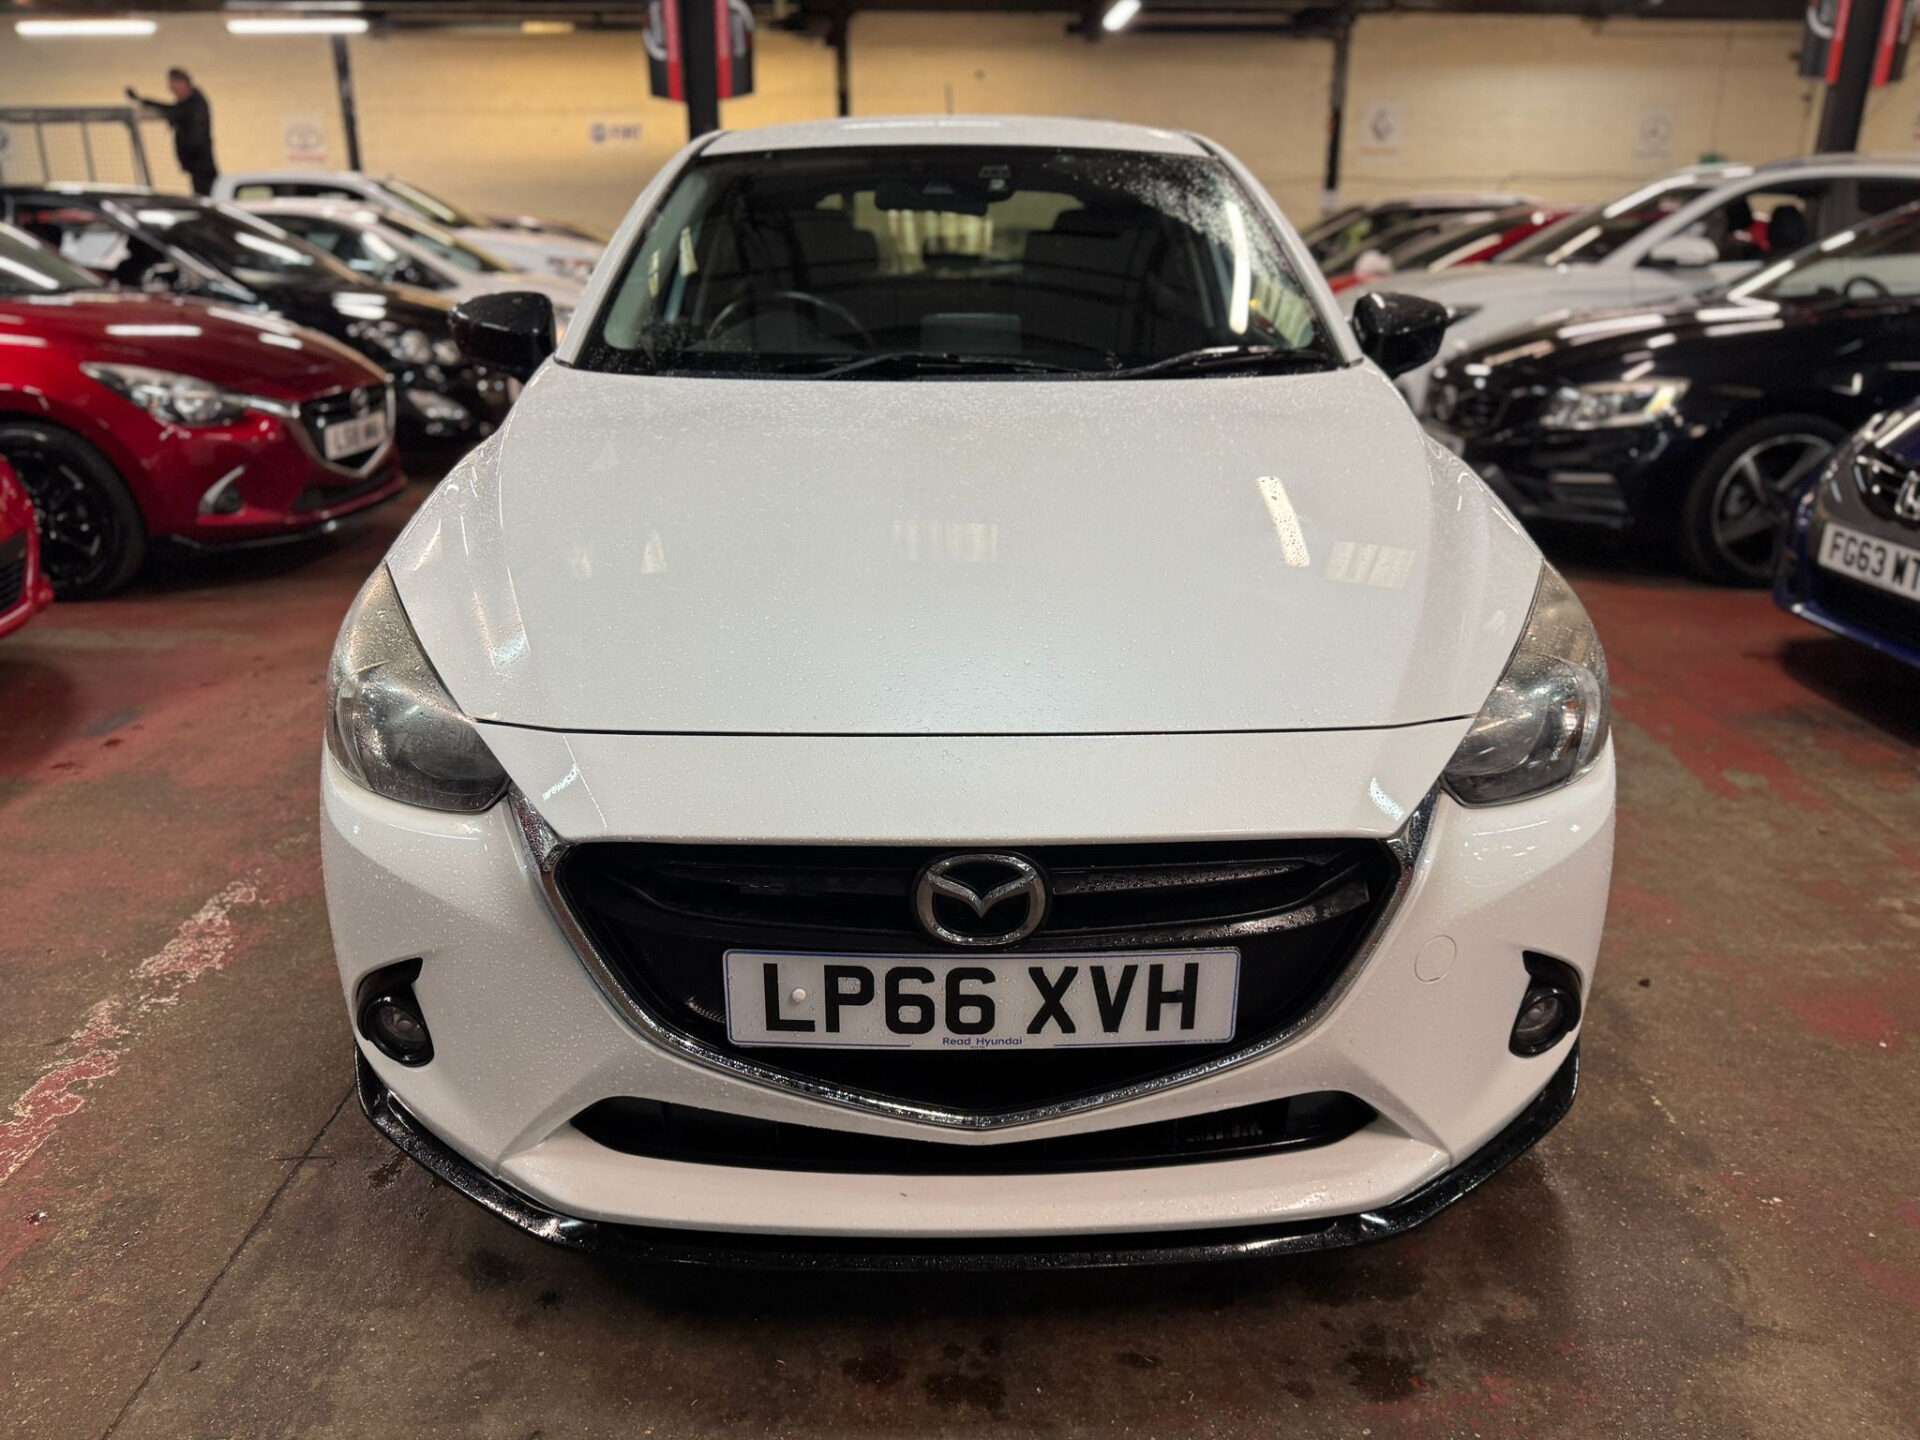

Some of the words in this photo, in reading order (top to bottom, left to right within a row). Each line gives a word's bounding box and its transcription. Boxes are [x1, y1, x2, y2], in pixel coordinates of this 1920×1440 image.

[1829, 531, 1888, 578] FG63
[763, 962, 996, 1035] LP66
[1027, 962, 1200, 1035] XVH
[942, 1037, 971, 1046] Read
[976, 1036, 1022, 1047] Hyundai
